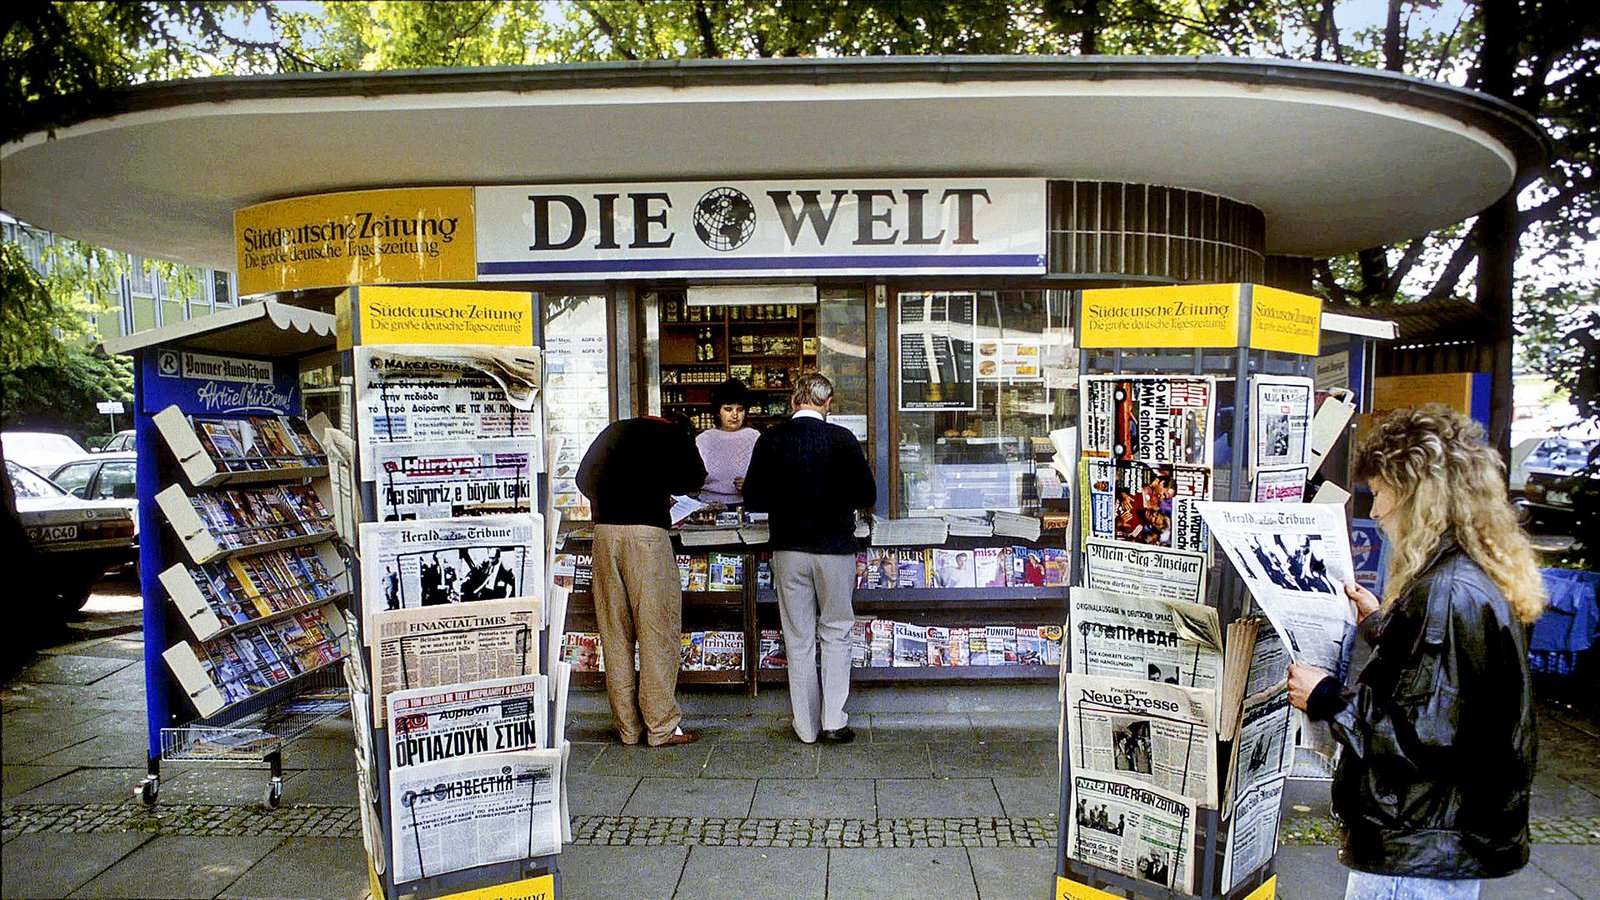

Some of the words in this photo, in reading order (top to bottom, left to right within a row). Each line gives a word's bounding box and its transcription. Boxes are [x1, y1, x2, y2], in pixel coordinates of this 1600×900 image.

[528, 192, 676, 251] DIE
[767, 188, 994, 247] WELT
[244, 220, 356, 250] Süddeutsche
[356, 212, 459, 243] Zeitung
[244, 252, 259, 268] Die
[290, 242, 340, 263] deutsche
[346, 239, 440, 260] Tageszeitung
[369, 302, 468, 320] Süddeutsche
[467, 303, 524, 322] Zeitung
[1087, 303, 1174, 319] Süddeutsche
[1174, 301, 1230, 320] Zeitung
[370, 319, 390, 330] Die
[391, 319, 419, 333] große
[421, 319, 465, 331] deutsche
[465, 320, 522, 333] Tageszeitung
[1089, 318, 1103, 330] Die
[1131, 318, 1168, 330] deutsche
[185, 353, 221, 375] Bonner
[223, 360, 271, 381] Rundschau
[1140, 378, 1155, 408] BMW
[1156, 378, 1166, 392] So
[197, 382, 246, 410] Aktuell
[246, 383, 263, 408] für
[1156, 394, 1169, 414] will
[1140, 409, 1154, 460] einholen
[467, 481, 501, 504] büyük
[1223, 511, 1255, 524] Herald
[1278, 512, 1315, 525] Tribune
[401, 530, 440, 543] Herald
[467, 528, 511, 541] Tribune
[716, 554, 743, 566] test
[410, 619, 472, 632] FINANCIAL
[473, 616, 507, 627] TIMES
[986, 627, 1015, 636] TUNING
[1046, 625, 1058, 635] PS
[704, 640, 744, 648] trinken
[712, 632, 737, 640] ssen
[1117, 625, 1178, 648] ПРАВДА
[1081, 689, 1124, 705] Neue
[1124, 693, 1180, 713] Presse
[495, 721, 537, 750] ΣΤΗΝ
[447, 775, 514, 800] ИЗВЕСТИЯ
[1107, 783, 1130, 800] NEUE
[1131, 787, 1156, 806] RHEIN
[1156, 795, 1190, 819] ZEITUNG
